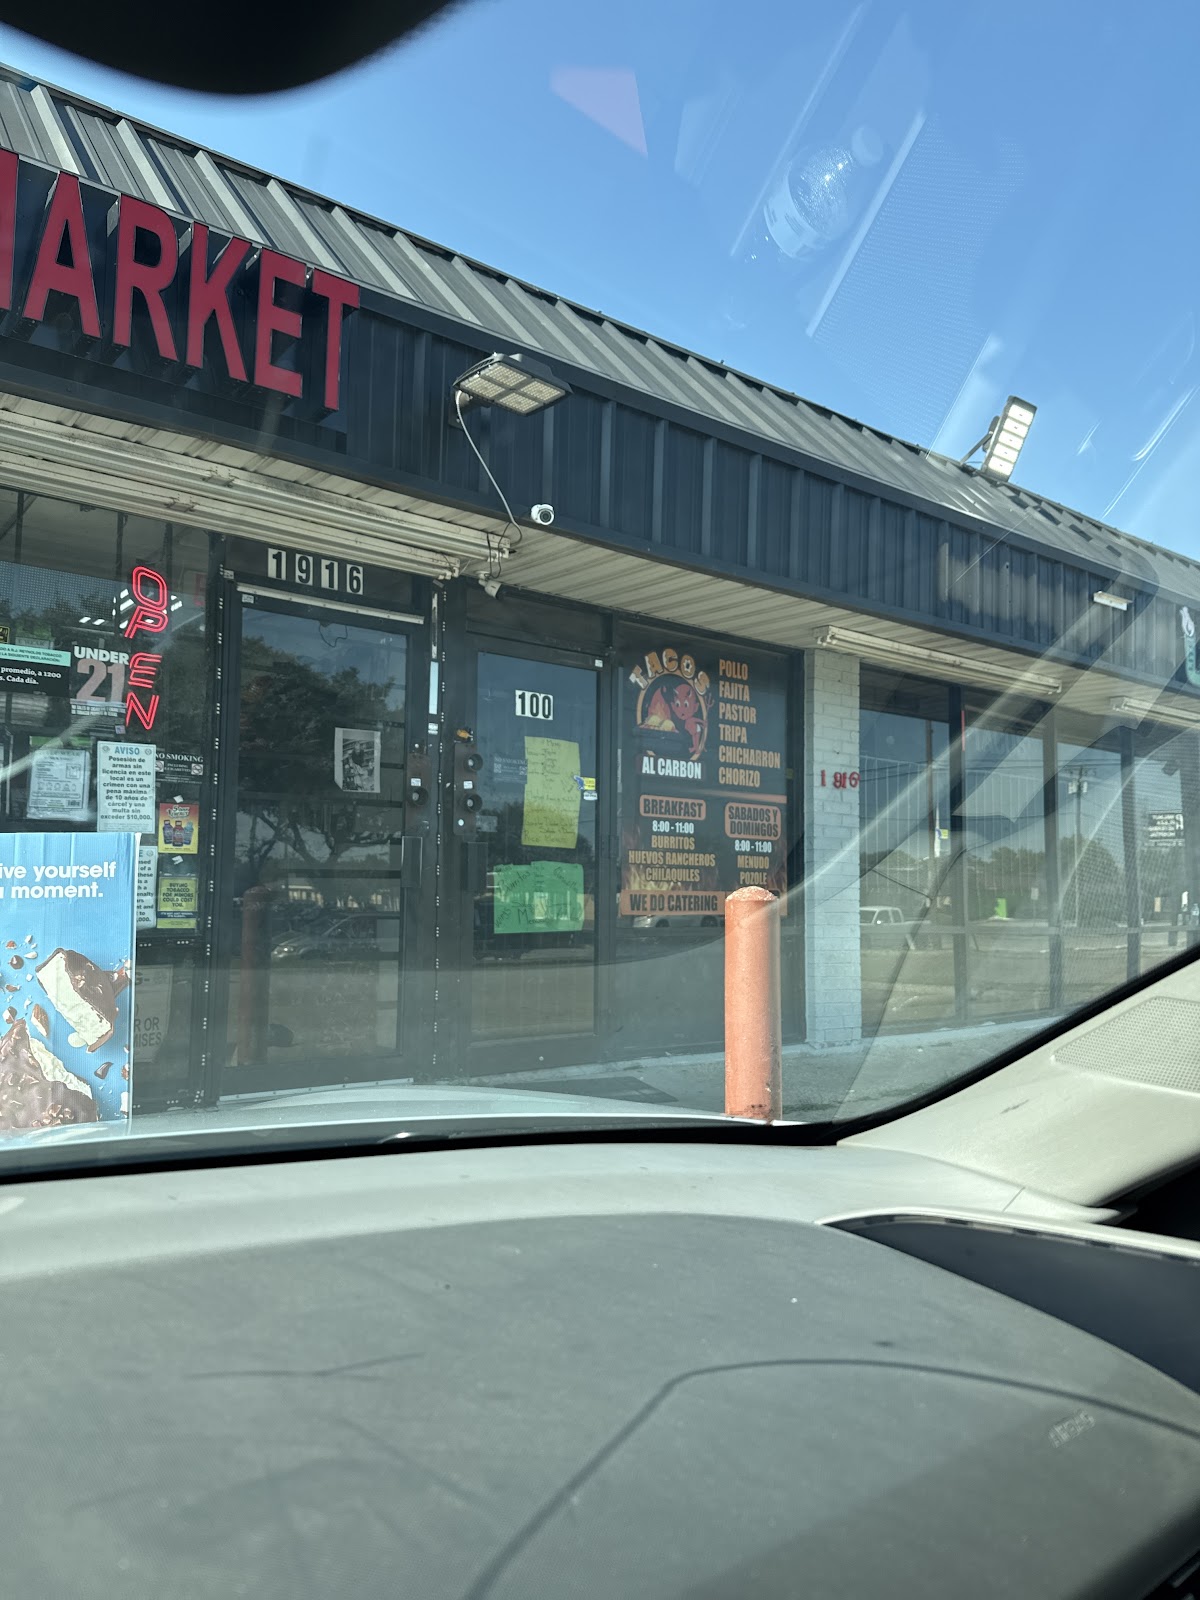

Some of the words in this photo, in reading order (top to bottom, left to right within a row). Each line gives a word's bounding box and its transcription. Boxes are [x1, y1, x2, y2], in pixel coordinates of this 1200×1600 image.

[271, 550, 363, 594] 1916
[74, 645, 129, 665] UNDER
[125, 566, 168, 730] OPEN
[1, 667, 37, 677] promedio,
[44, 671, 62, 679] 1200
[629, 648, 710, 696] TACOS
[719, 659, 748, 681] POLLO
[6, 675, 24, 683] Cada
[25, 677, 39, 685] día.
[75, 658, 126, 702] 21
[719, 681, 750, 702] FAJITA
[518, 691, 552, 719] 100
[719, 702, 757, 724] PASTOR
[719, 724, 748, 744] TRIPA
[114, 746, 140, 755] AVISO
[166, 753, 204, 763] SMOKING
[719, 745, 781, 769] CHICHARRON
[642, 756, 655, 774] AL
[658, 757, 702, 779] CARBON
[719, 767, 761, 788] CHORIZO
[643, 798, 703, 818] BREAKFAST
[728, 805, 771, 823] SABADOS
[772, 809, 779, 823] Y
[652, 820, 670, 833] 8:00
[675, 822, 694, 834] 11:00
[730, 820, 779, 838] DOMINGOS
[651, 834, 695, 850] BURRITOS
[734, 839, 750, 852] 8:00
[755, 841, 772, 853] 11:00
[628, 850, 664, 865] HUEVOS
[665, 852, 716, 867] RANCHEROS
[737, 855, 770, 869] MENUDO
[33, 861, 117, 882] yourself
[645, 868, 700, 882] CHILAQUILES
[739, 871, 767, 885] POZOLE
[11, 881, 104, 899] moment.
[630, 894, 648, 911] WE
[650, 895, 665, 911] DO
[667, 895, 718, 912] CATERING
[144, 1016, 160, 1031] OR
